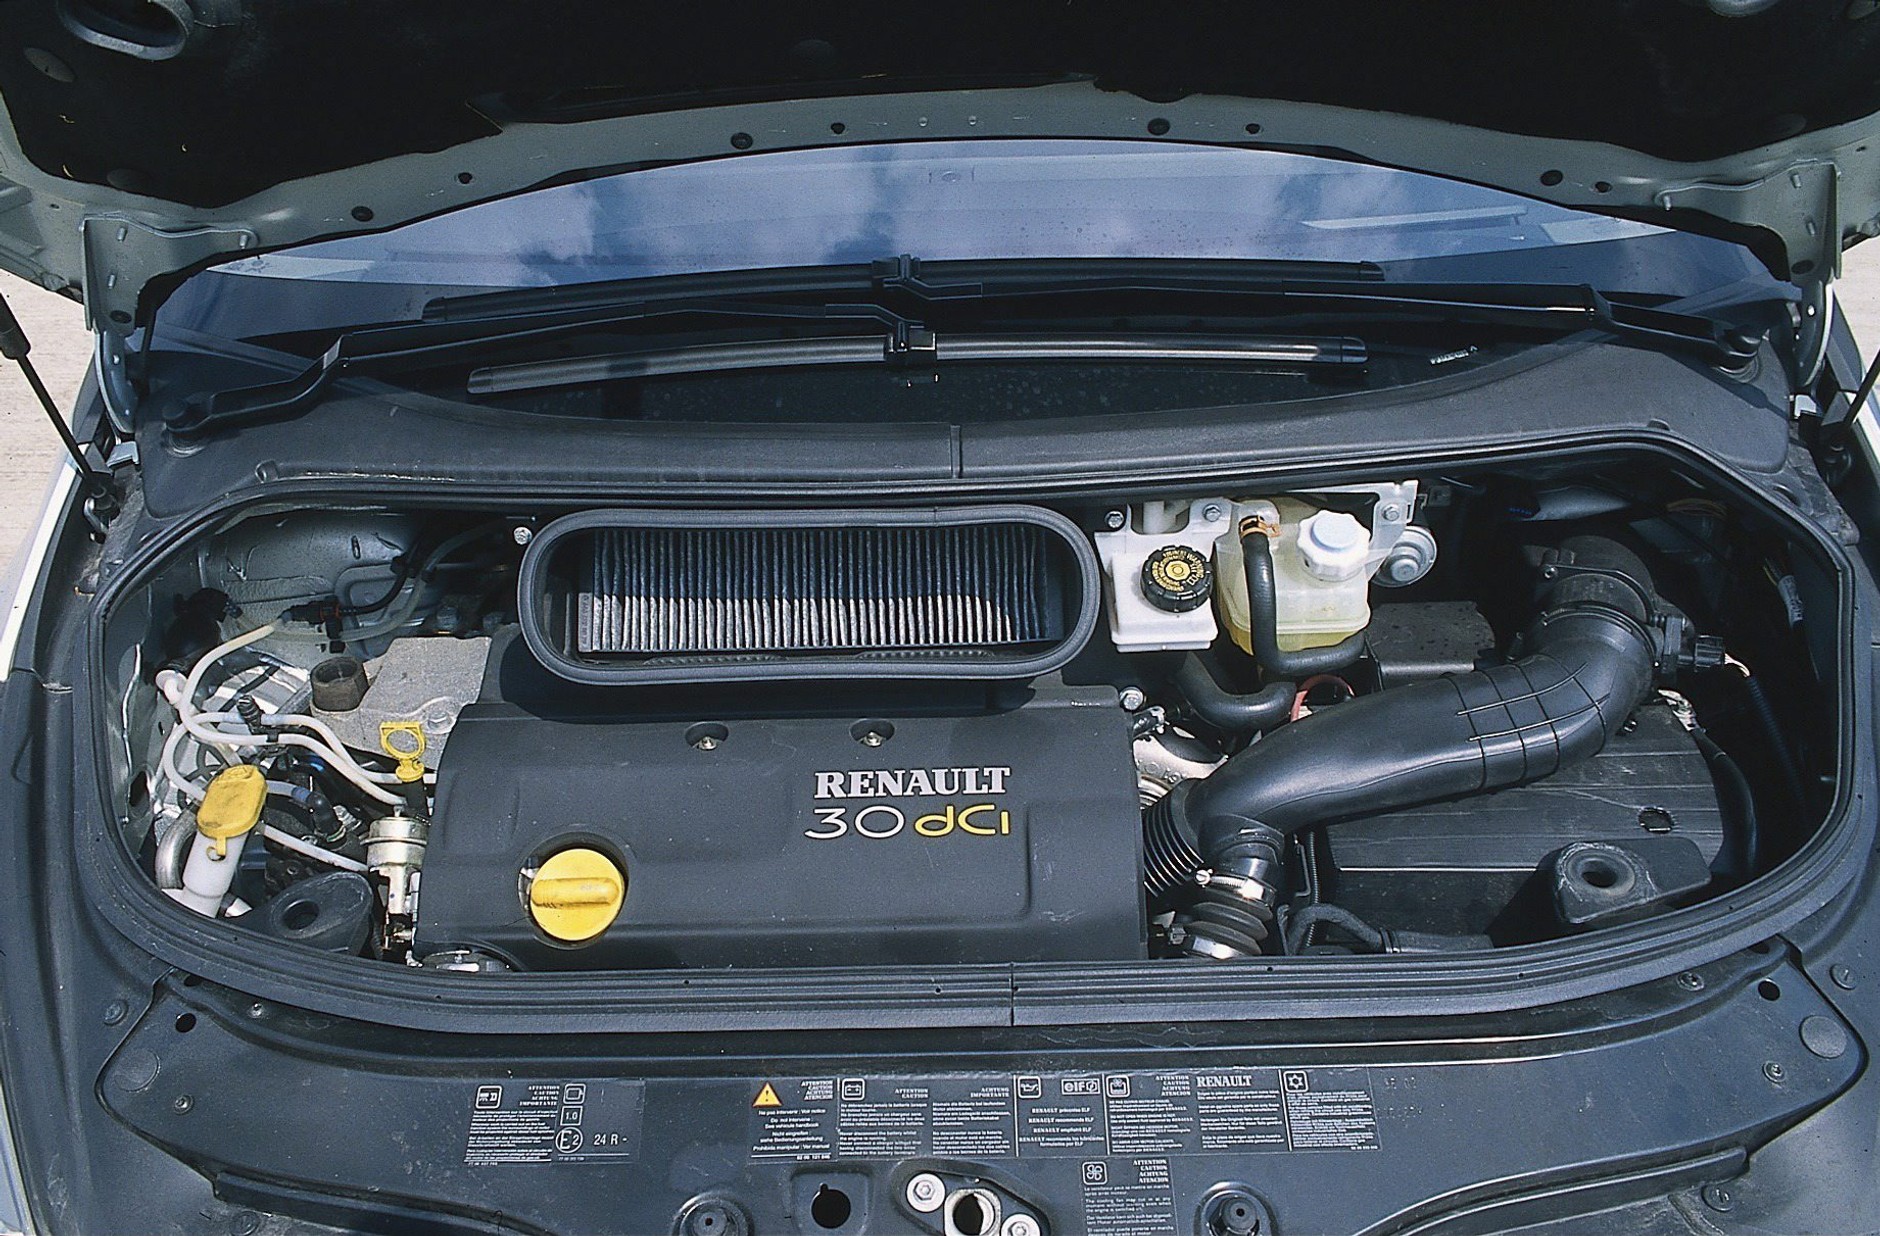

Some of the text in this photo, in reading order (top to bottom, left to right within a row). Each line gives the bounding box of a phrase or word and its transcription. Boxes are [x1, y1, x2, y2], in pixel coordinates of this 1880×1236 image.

[814, 767, 1010, 798] RENAULT
[804, 805, 905, 840] 30
[1196, 1076, 1252, 1087] RENAULT
[566, 1112, 578, 1120] 1.0
[594, 1134, 618, 1146] 24 R
